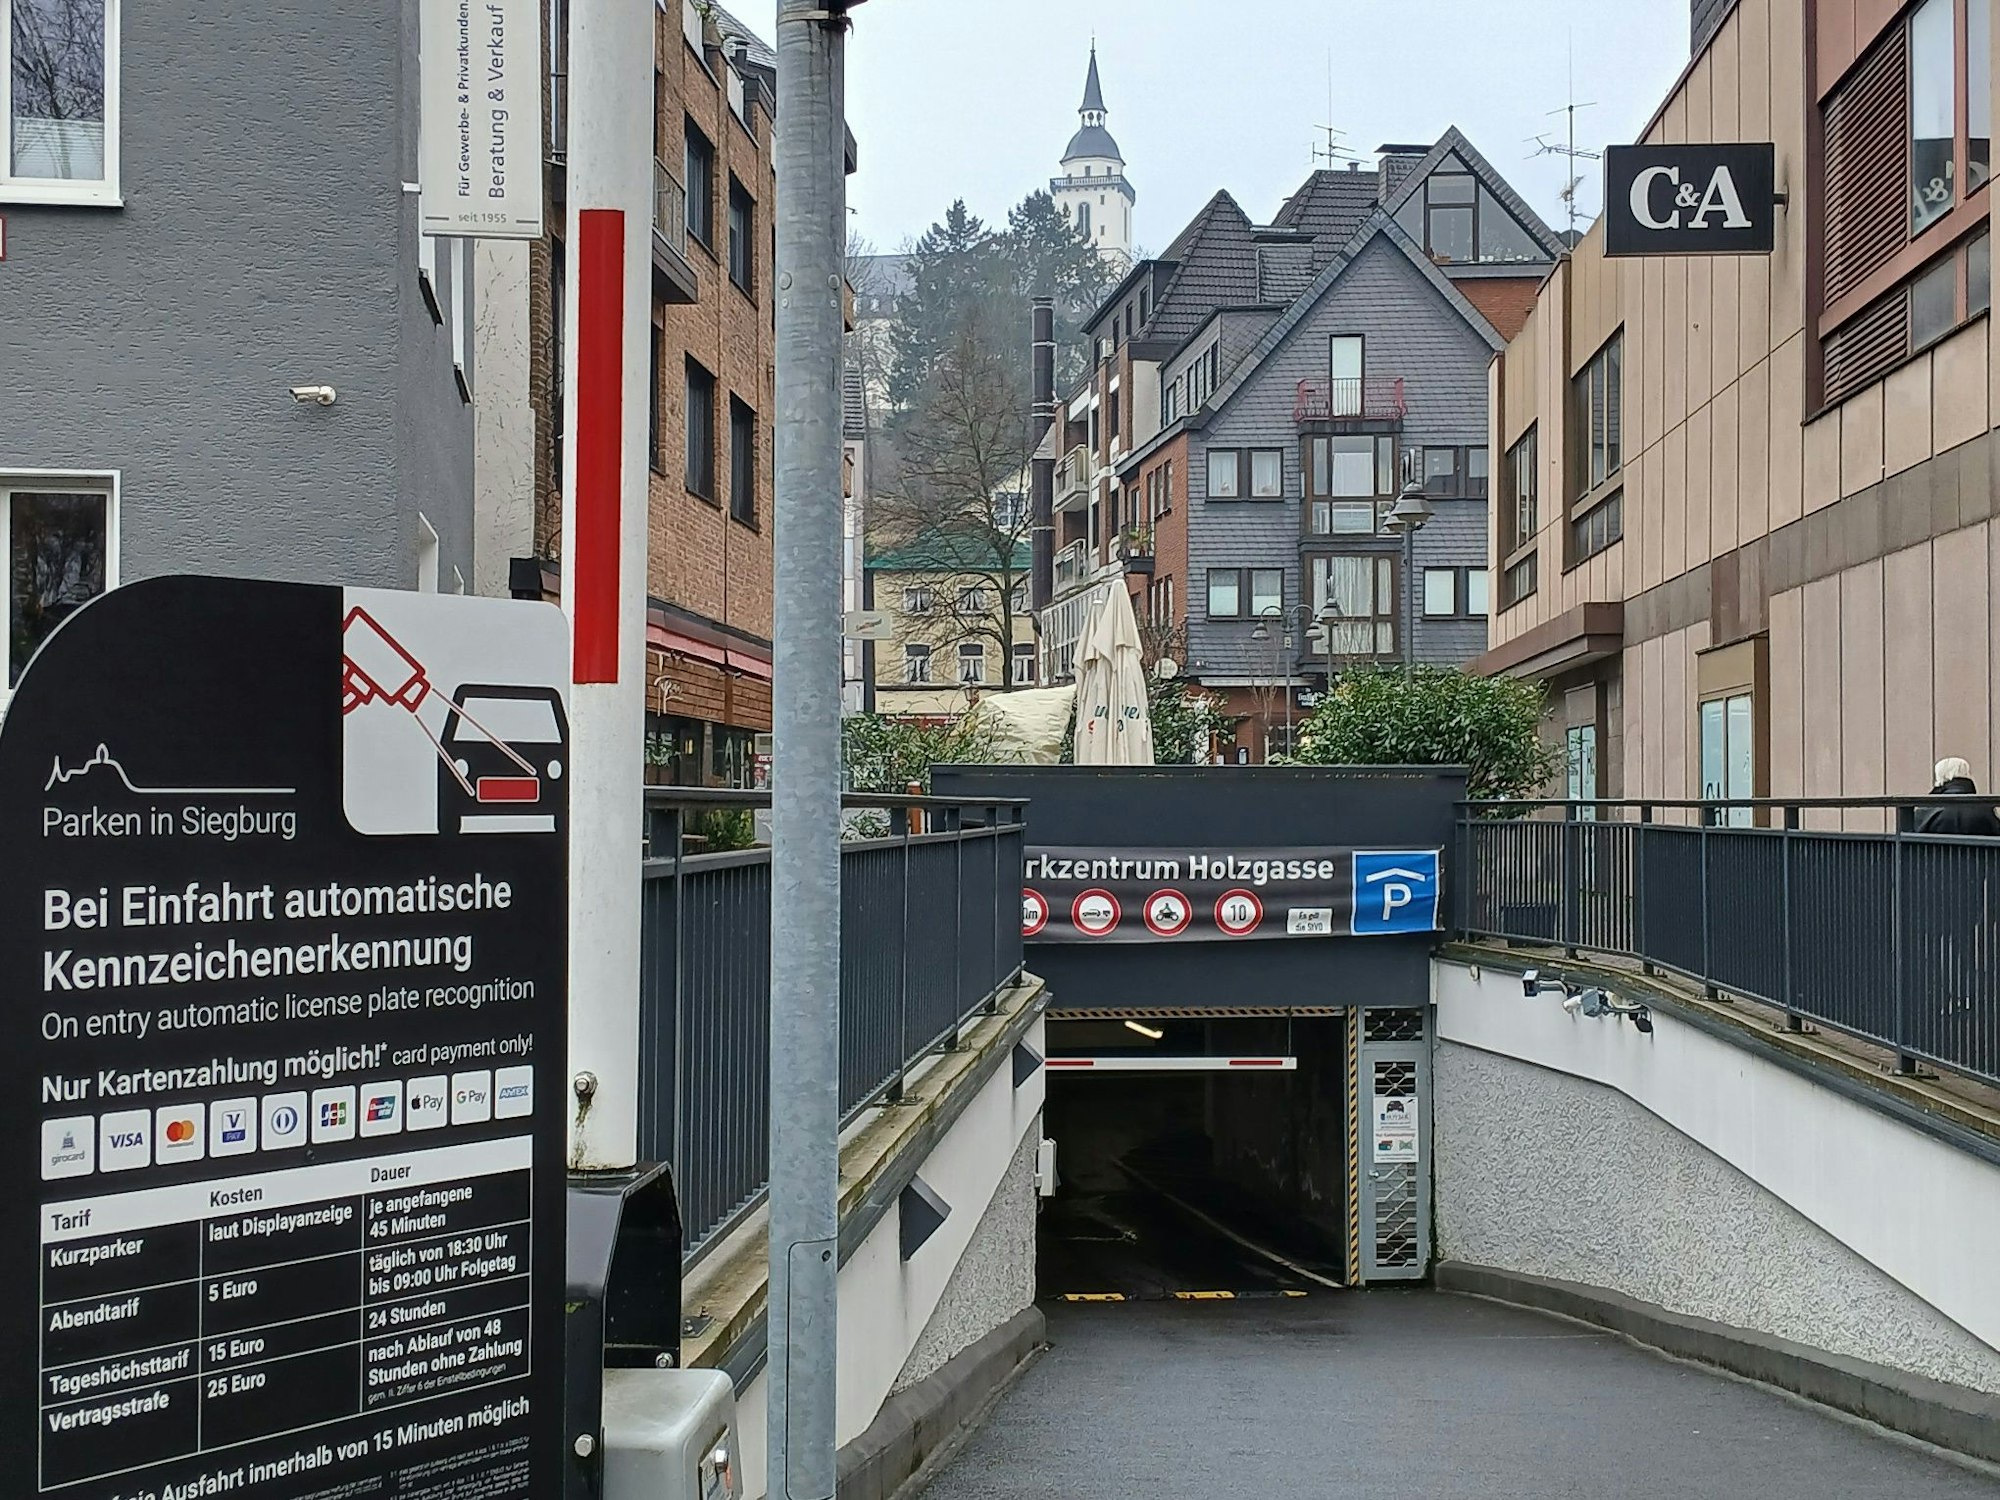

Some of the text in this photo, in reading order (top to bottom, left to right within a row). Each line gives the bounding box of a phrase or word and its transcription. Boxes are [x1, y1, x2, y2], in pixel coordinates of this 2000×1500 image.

[458, 93, 470, 104] &
[487, 5, 509, 198] Beratung & Verkauf
[458, 109, 470, 172] Gewerbe-
[458, 177, 470, 197] Für
[1629, 165, 1752, 230] C&A
[459, 213, 507, 222] seit 1955
[43, 807, 296, 841] Parken in Siegburg
[1024, 856, 1334, 885] rkzentrum Holzgasse
[44, 873, 511, 930] Bei Einfahrt automatische
[1231, 904, 1247, 922] 10
[1383, 884, 1412, 920] P
[43, 933, 472, 991] Kennzeichenerkennung
[42, 977, 534, 1043] On entry automatic license plate recognition
[42, 1074, 90, 1103] Nur
[98, 1055, 278, 1098] Kartenzahlung
[392, 1043, 428, 1066] card
[430, 1037, 496, 1066] payment
[499, 1034, 533, 1057] only!
[424, 1094, 443, 1111] Pay
[457, 1090, 485, 1104] G Pay
[499, 1085, 529, 1099] AMEX
[227, 1114, 240, 1129] V
[321, 1108, 346, 1120] JCB
[109, 1132, 143, 1149] VISA
[370, 1163, 411, 1183] Dauer
[209, 1185, 263, 1207] Kosten
[369, 1185, 473, 1219] je angefangene
[51, 1209, 91, 1232] Tarif
[208, 1205, 352, 1242] laut Displayanzeige
[369, 1212, 446, 1238] 45 Minuten
[50, 1237, 143, 1269] Kurzparker
[369, 1233, 508, 1274] täglich von 18:30 Uhr
[209, 1278, 257, 1301] 5 Euro
[369, 1252, 516, 1296] bis 09:00 Uhr Folgetag
[49, 1298, 140, 1332] Abendtarif
[368, 1299, 446, 1330] 24 Stunden
[208, 1337, 264, 1362] 15 Euro
[368, 1320, 501, 1362] nach Ablauf von 48
[49, 1347, 189, 1397] Tageshöchsttarif
[368, 1339, 522, 1386] Stunden ohne Zahlung
[208, 1370, 265, 1398] 25 Euro
[49, 1390, 169, 1433] Vertragsstrafe
[337, 1396, 530, 1462] von 15 Minuten möglich
[161, 1467, 244, 1500] Ausfahrt
[249, 1444, 332, 1485] innerhalb
